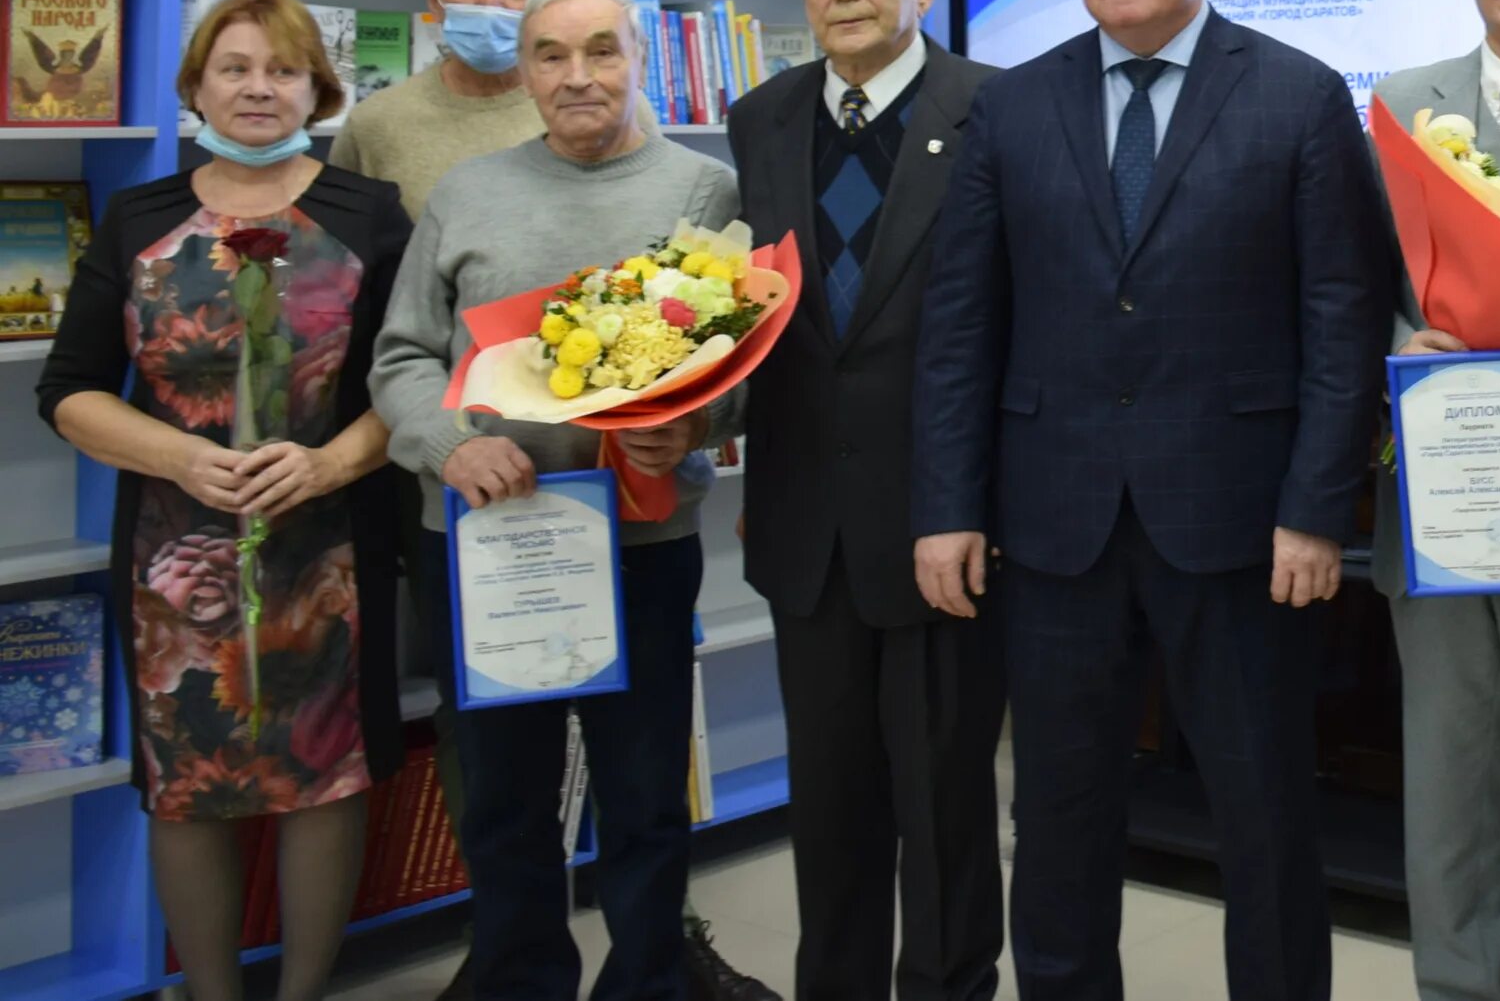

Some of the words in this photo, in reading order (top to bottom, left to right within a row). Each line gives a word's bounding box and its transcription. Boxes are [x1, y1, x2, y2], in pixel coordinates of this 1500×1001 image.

[32, 10, 96, 30] НАРОДА
[1258, 9, 1302, 21] «ГОРОД
[1304, 6, 1364, 19] САРАТОВ»
